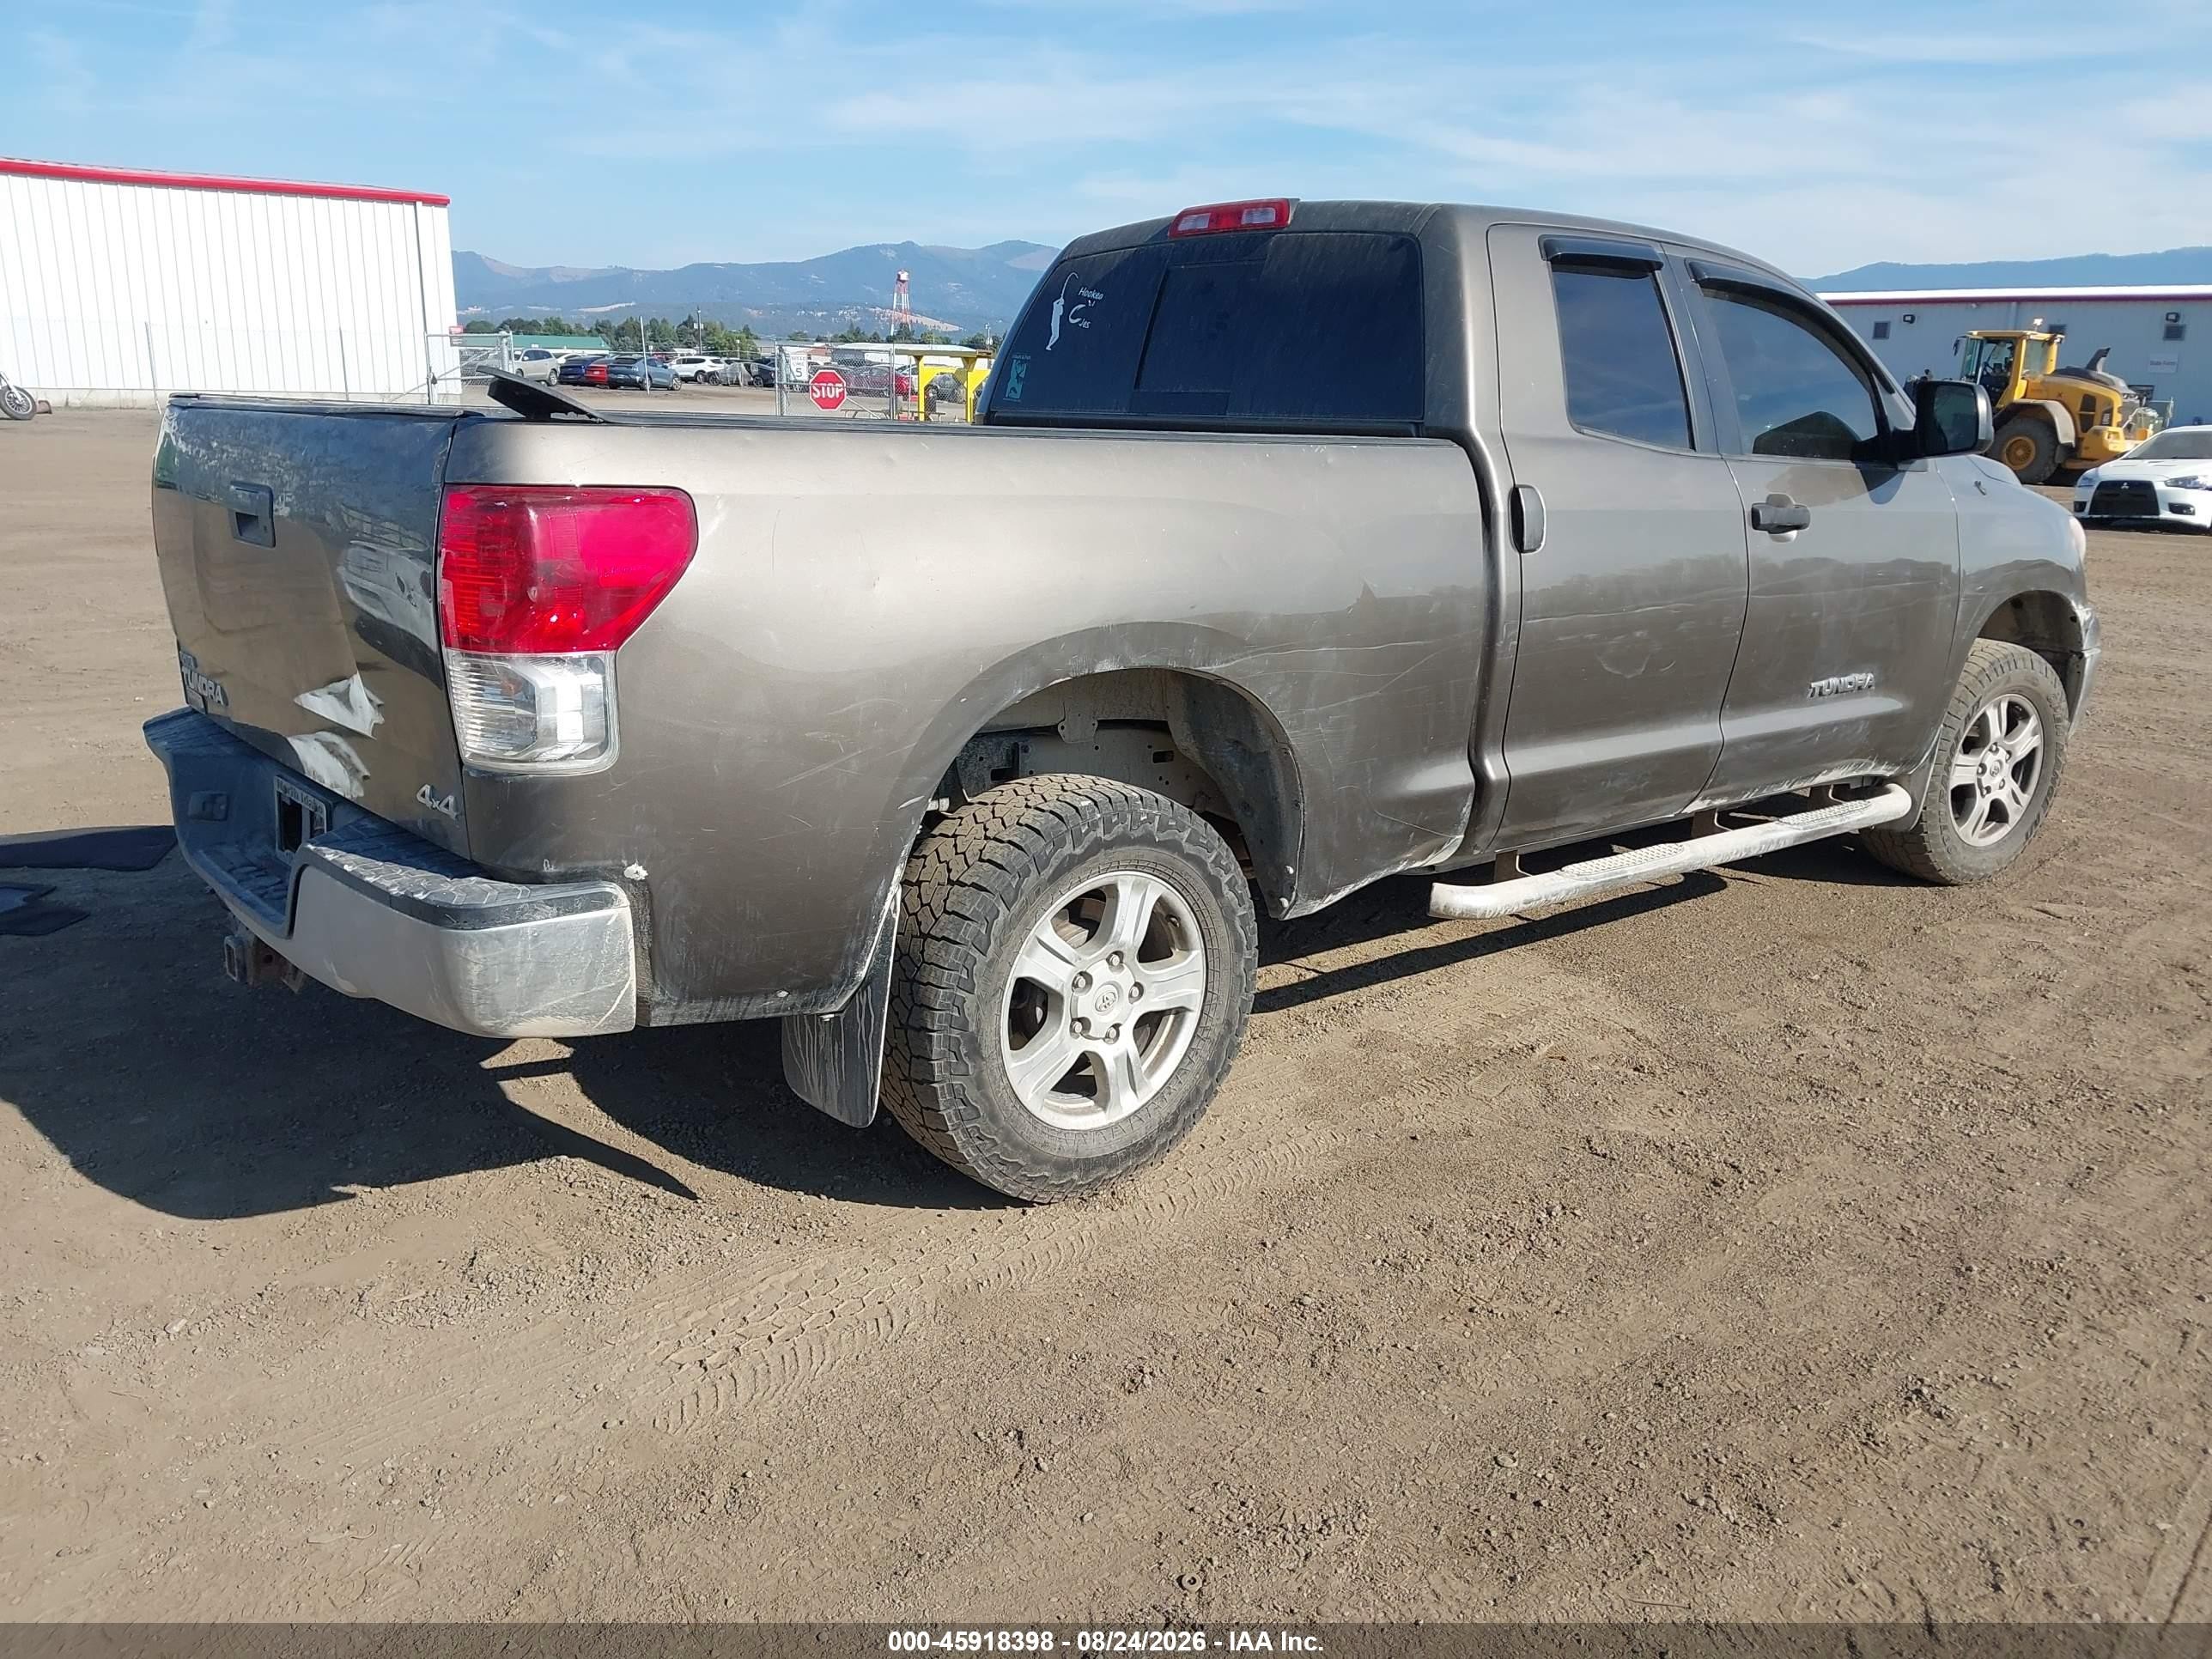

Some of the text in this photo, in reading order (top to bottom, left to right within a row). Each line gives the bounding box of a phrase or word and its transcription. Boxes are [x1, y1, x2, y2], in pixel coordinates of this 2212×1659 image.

[795, 368, 803, 378] 5
[812, 383, 844, 398] STOP
[181, 666, 224, 706] TUNDRA
[1807, 672, 1875, 700] TUNDRA
[416, 784, 457, 820] 4x4
